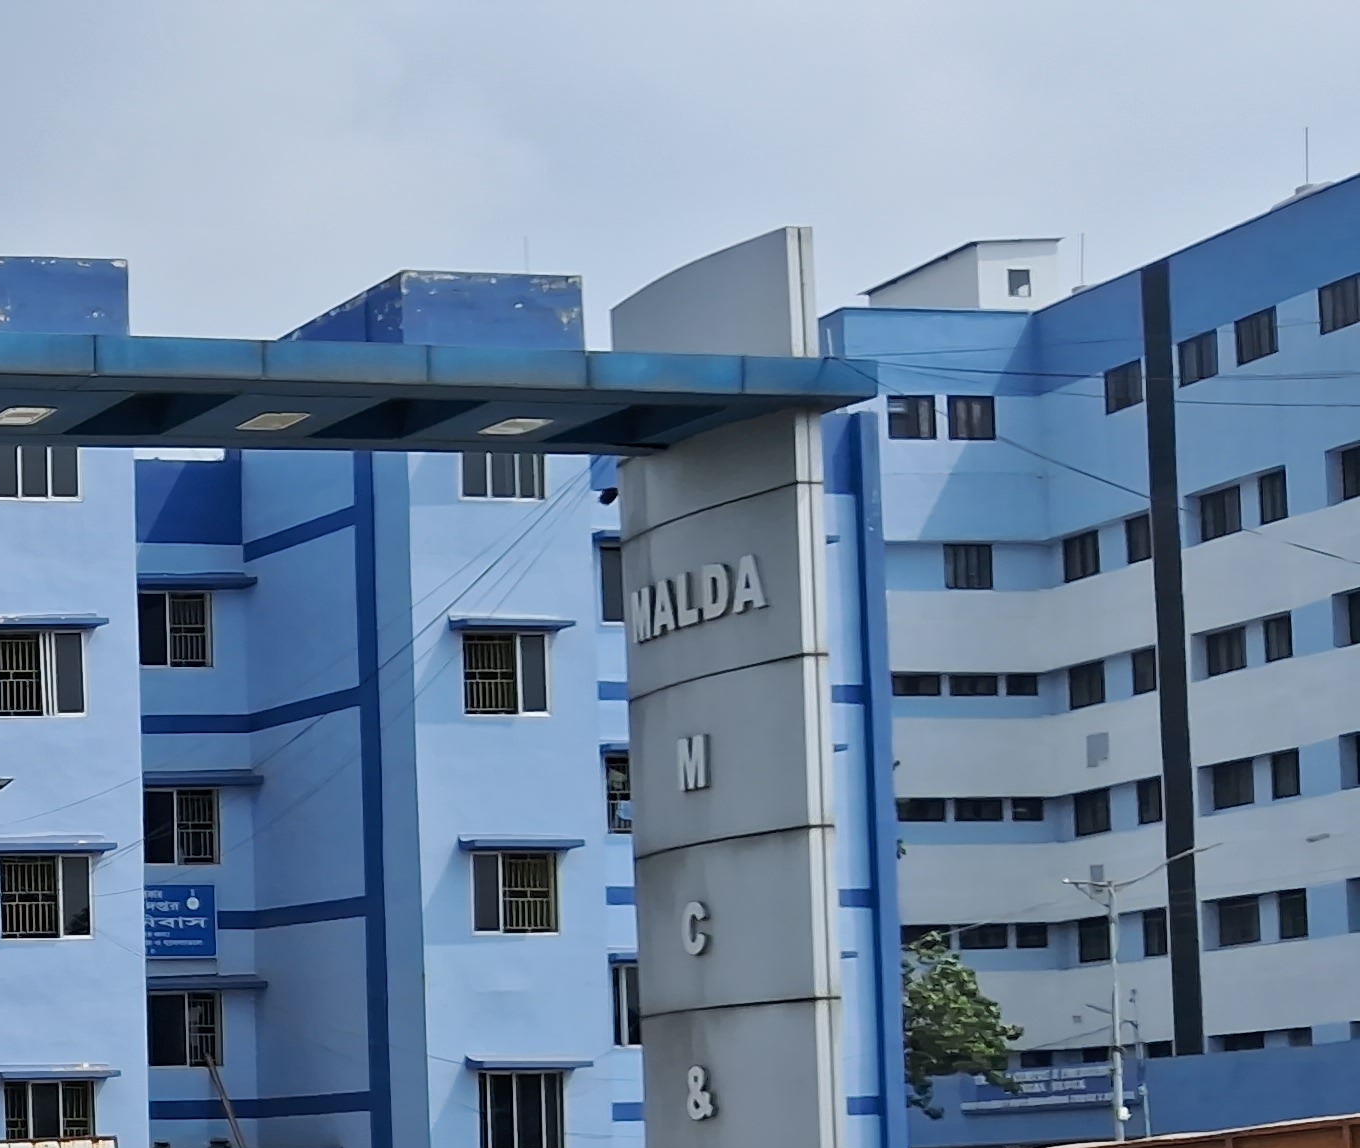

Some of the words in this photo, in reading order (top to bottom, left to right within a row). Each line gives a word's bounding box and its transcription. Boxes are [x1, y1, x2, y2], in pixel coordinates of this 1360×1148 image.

[630, 553, 769, 644] MALDA
[677, 733, 711, 792] M
[682, 900, 710, 956] C
[686, 1064, 718, 1122] &
